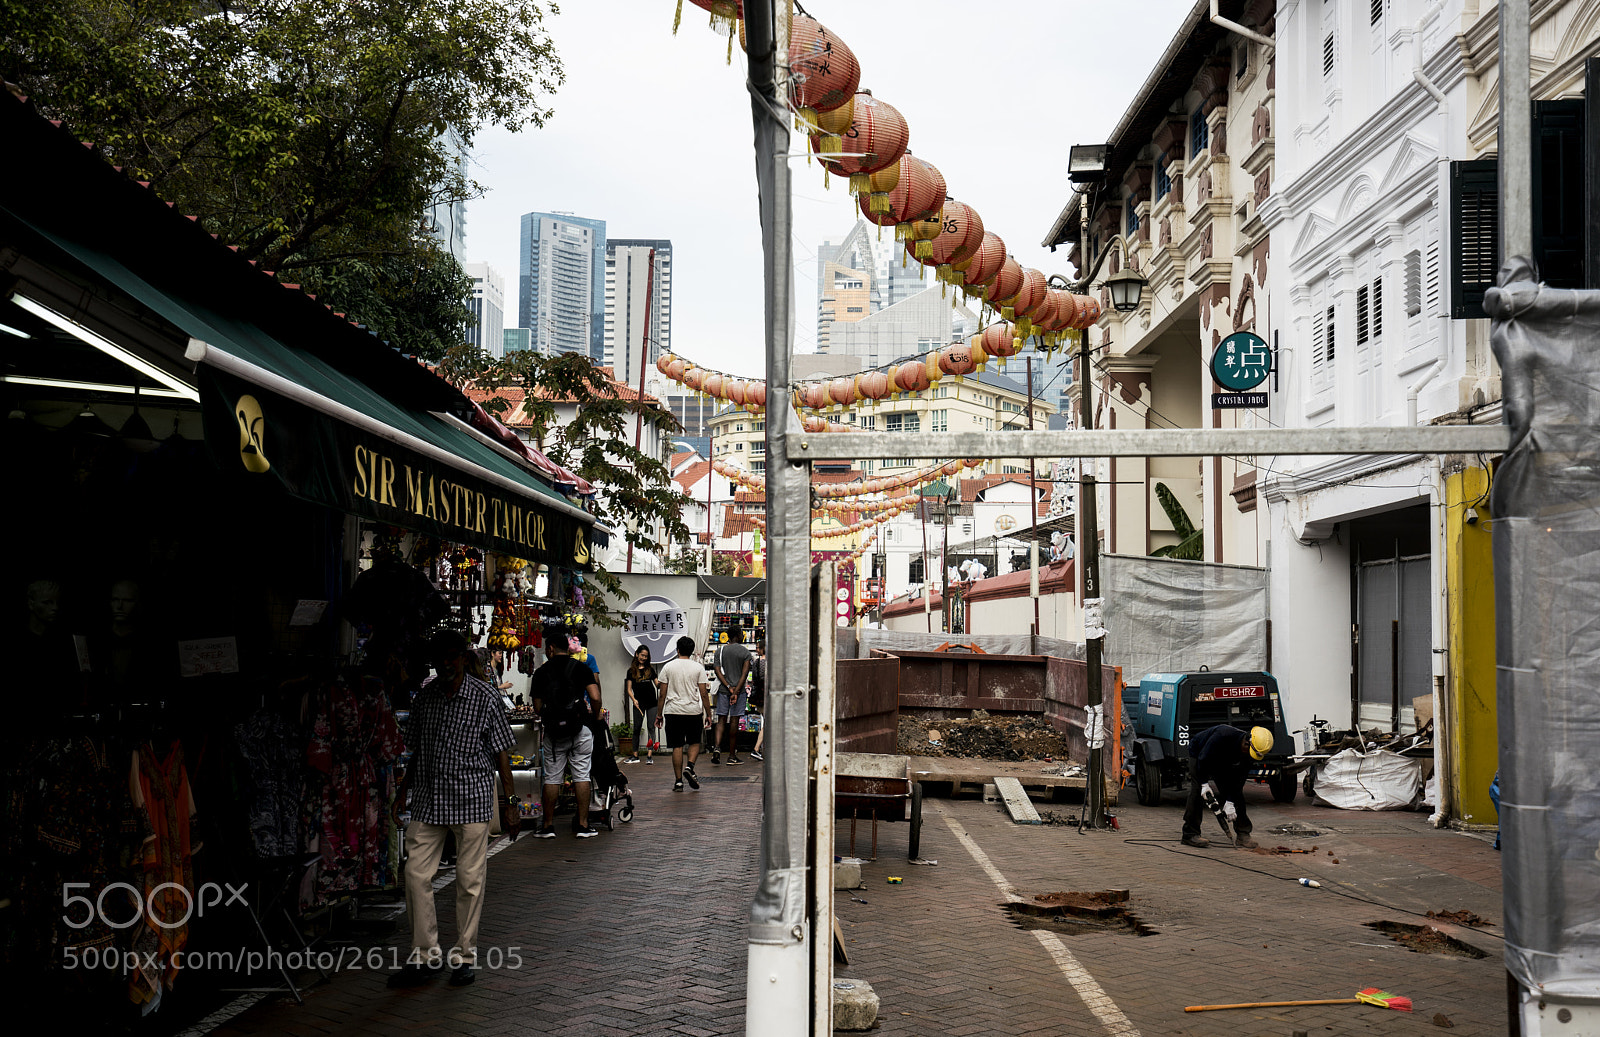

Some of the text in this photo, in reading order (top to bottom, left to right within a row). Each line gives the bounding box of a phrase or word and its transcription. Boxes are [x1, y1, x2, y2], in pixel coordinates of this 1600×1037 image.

[1232, 338, 1267, 379] 点
[1217, 395, 1264, 405] CRYSTAL JADE
[354, 444, 547, 551] SIR MASTER TAILOR
[1178, 725, 1190, 746] 285
